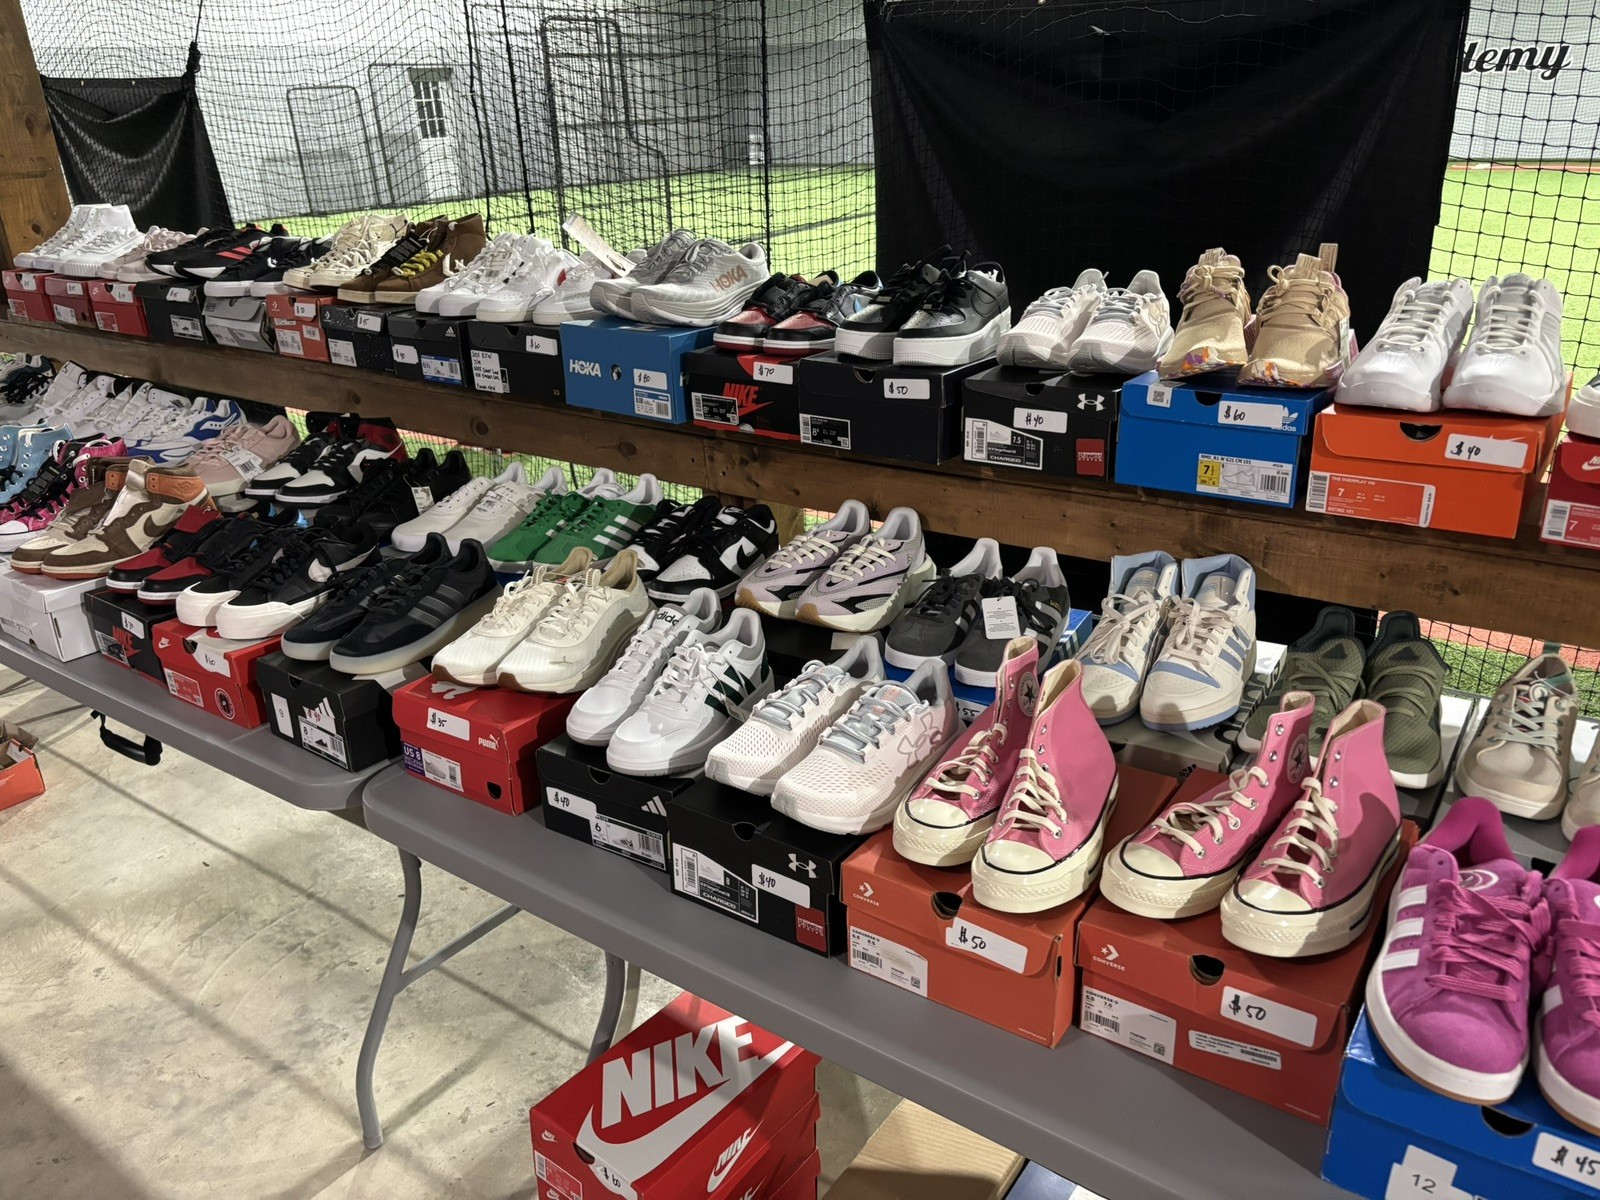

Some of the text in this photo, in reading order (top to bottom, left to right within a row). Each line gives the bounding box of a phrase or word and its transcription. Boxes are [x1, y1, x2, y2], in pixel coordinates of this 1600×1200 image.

[709, 264, 748, 293] HOKA
[569, 359, 602, 378] HOKA
[758, 364, 775, 377] $70
[723, 382, 759, 408] NIKE
[1223, 404, 1246, 422] $60
[1451, 440, 1481, 460] $40
[1338, 487, 1345, 497] 7
[1569, 520, 1578, 531] 7
[403, 745, 415, 758] US
[478, 737, 499, 750] PUMA
[594, 822, 602, 832] 6
[758, 872, 776, 889] $40
[853, 893, 880, 907] CONVERSE
[958, 926, 987, 950] $50
[1092, 955, 1126, 972] CONVERSE
[1228, 994, 1267, 1021] $50
[602, 1015, 759, 1129] NIKE
[715, 1126, 752, 1172] NIKE
[1411, 1173, 1437, 1194] 12
